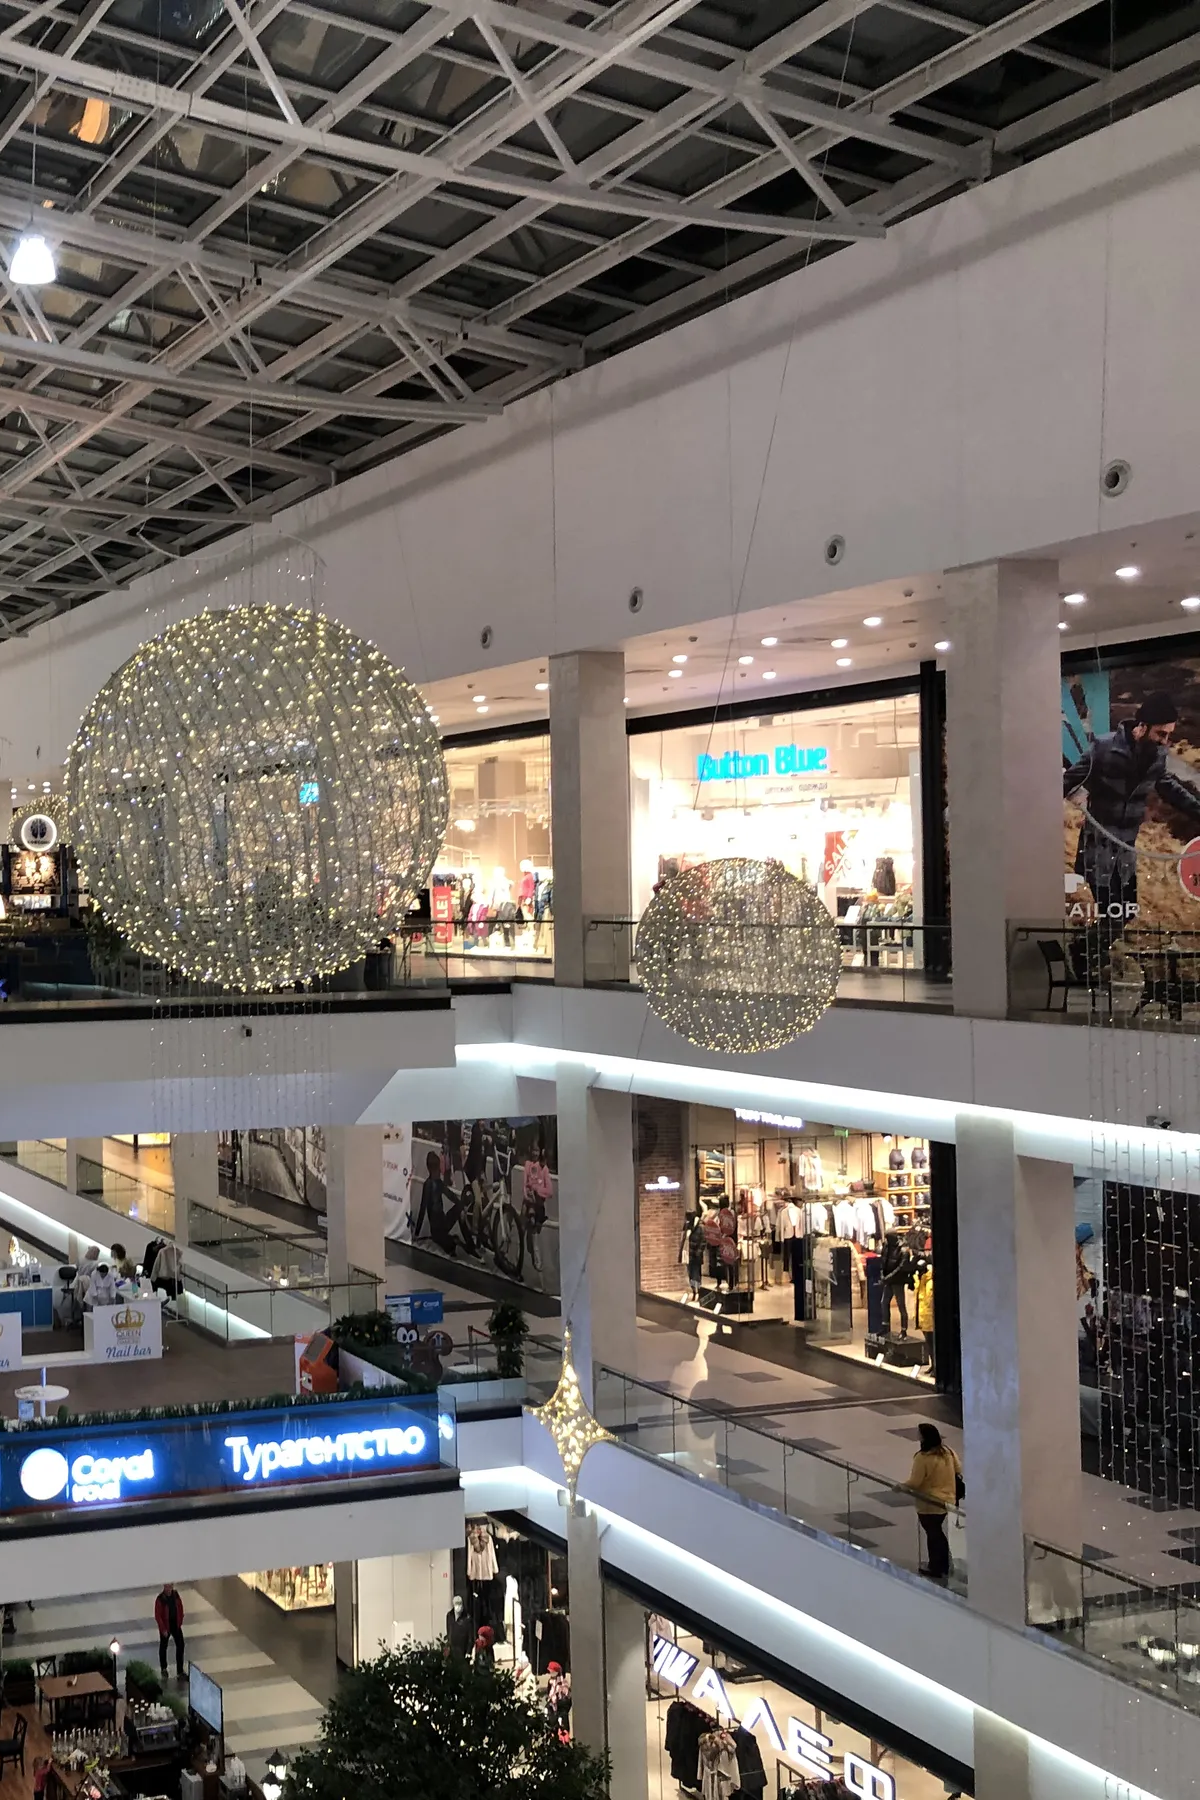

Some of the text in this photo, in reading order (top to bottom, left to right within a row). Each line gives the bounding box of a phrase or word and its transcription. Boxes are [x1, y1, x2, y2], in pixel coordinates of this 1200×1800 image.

[697, 744, 827, 781] Button Blue
[116, 1328, 141, 1338] QUEEN
[106, 1344, 152, 1359] Nail bar
[72, 1449, 154, 1485] Coral
[225, 1426, 425, 1480] Турагентство
